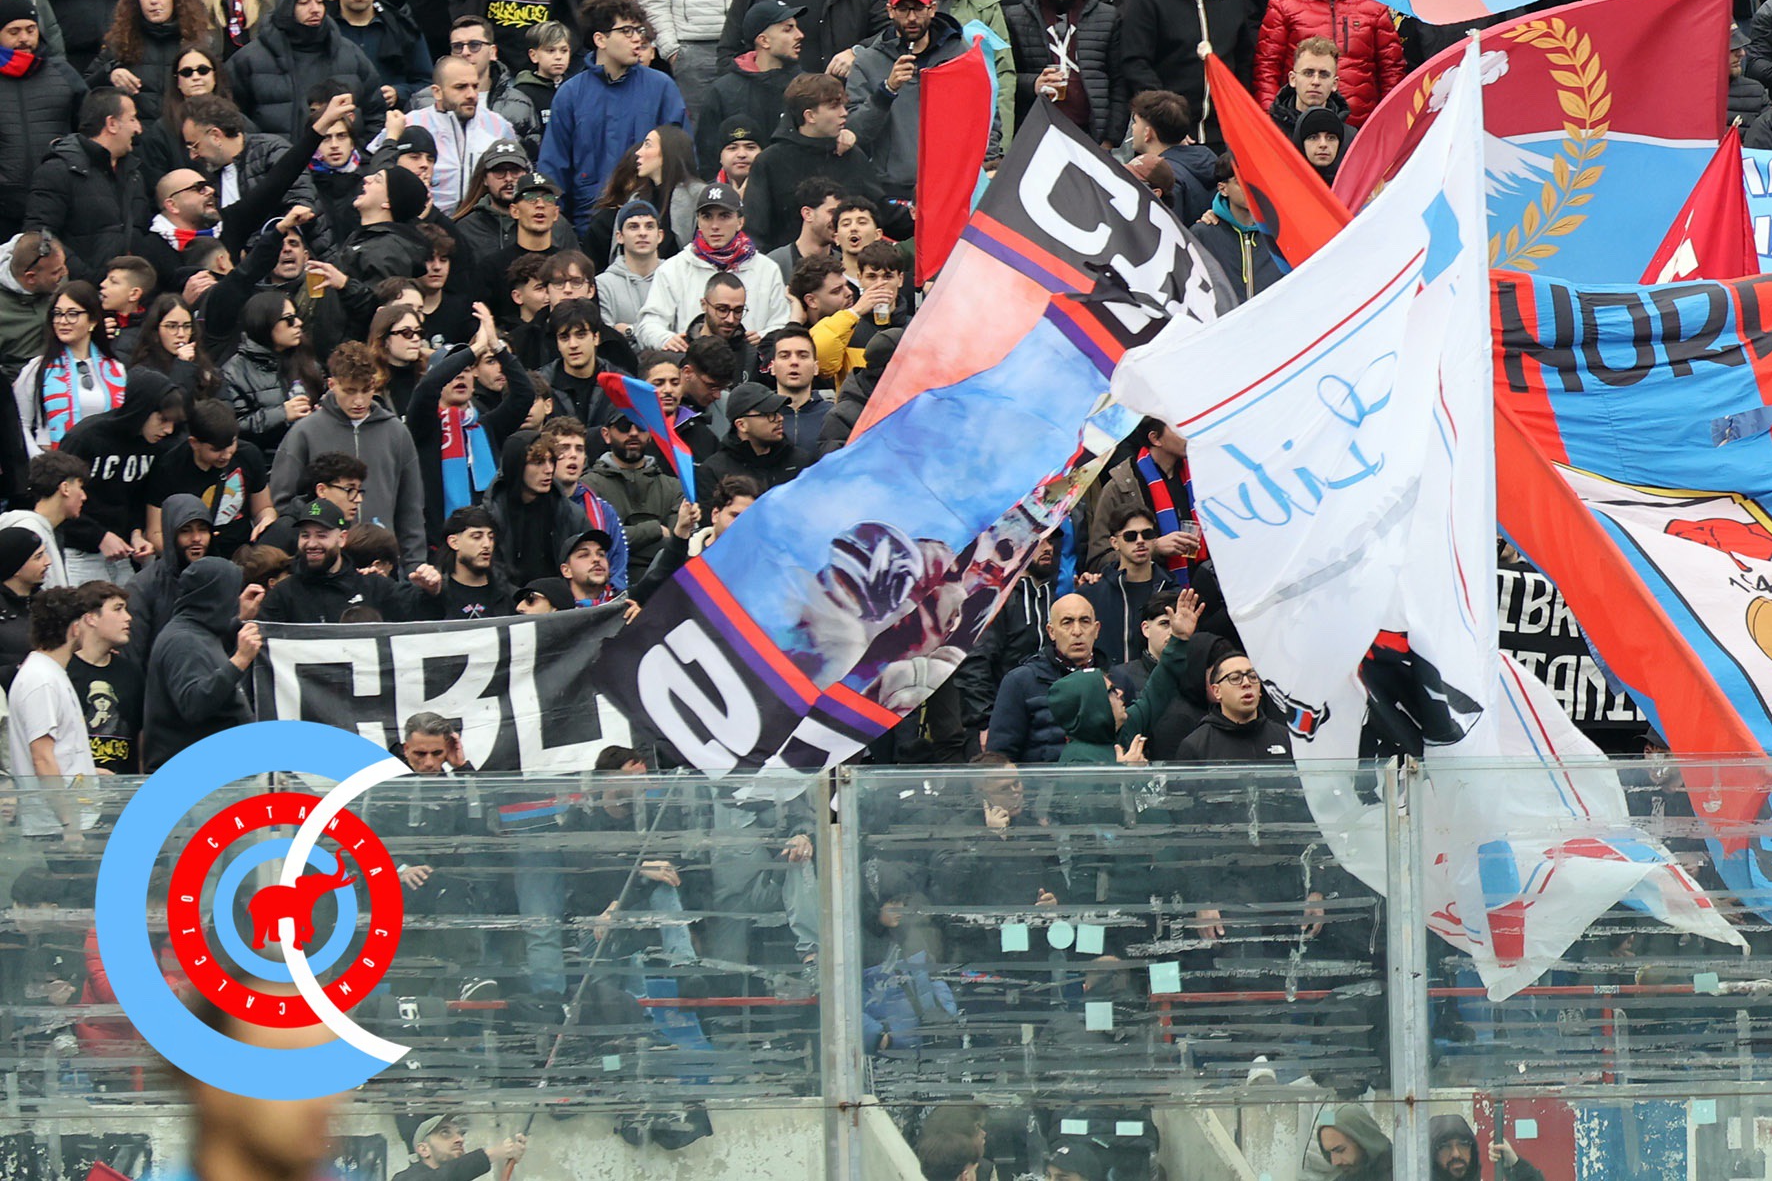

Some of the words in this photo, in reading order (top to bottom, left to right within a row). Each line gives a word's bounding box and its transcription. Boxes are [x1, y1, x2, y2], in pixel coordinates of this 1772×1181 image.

[533, 172, 547, 185] LA
[708, 187, 724, 200] NY
[90, 454, 156, 483] ICON
